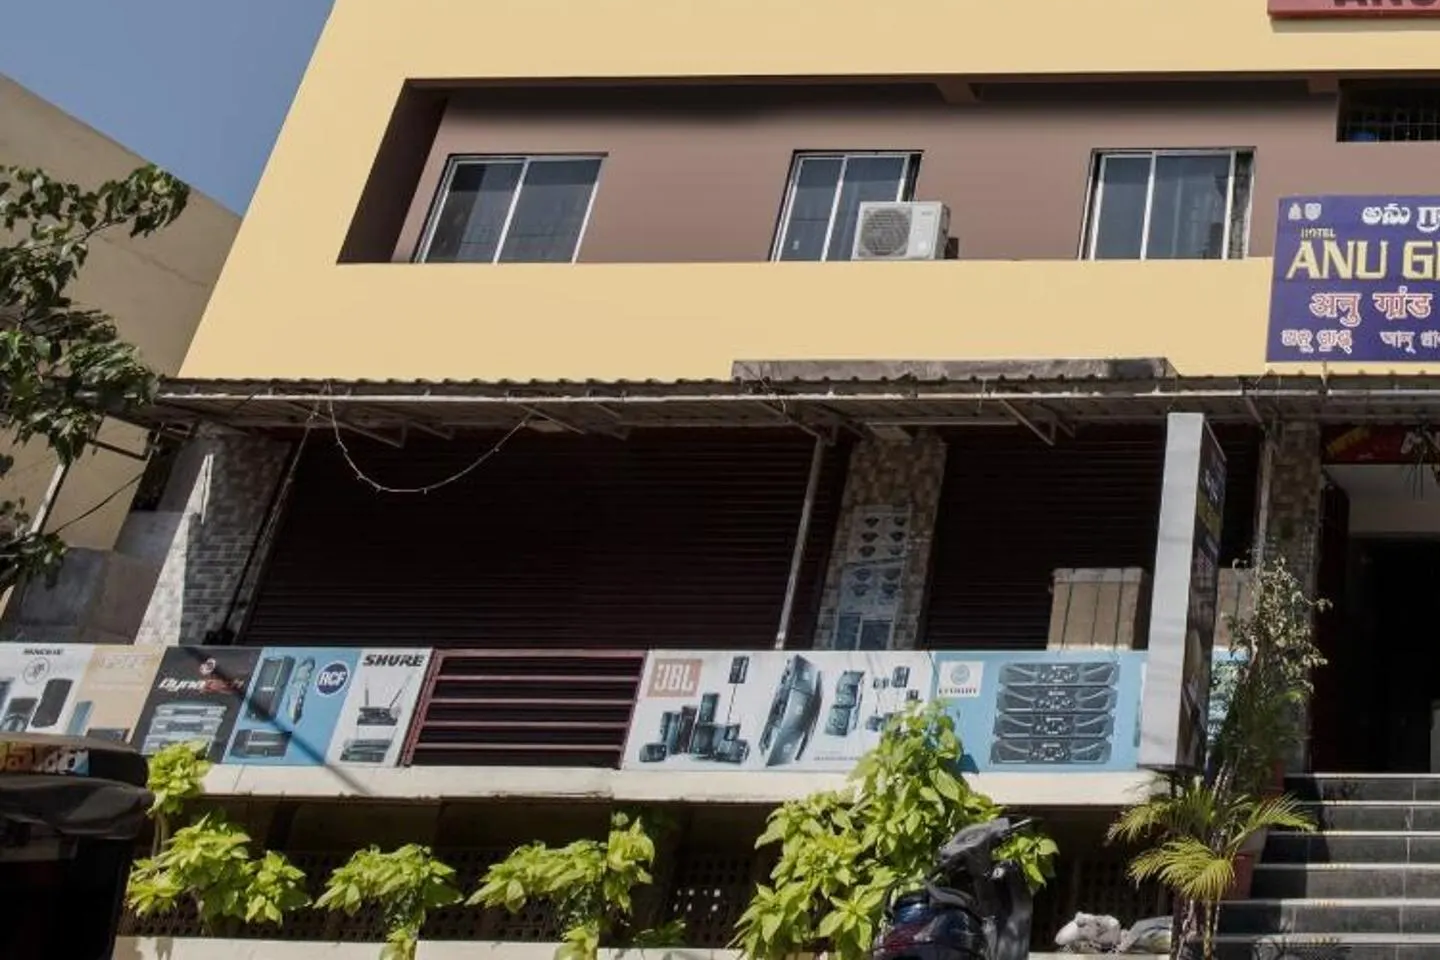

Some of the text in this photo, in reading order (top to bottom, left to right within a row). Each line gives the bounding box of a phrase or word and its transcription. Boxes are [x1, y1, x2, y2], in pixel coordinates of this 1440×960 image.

[1301, 227, 1337, 239] HOTEL
[1286, 241, 1389, 280] ANU
[363, 653, 425, 668] SHURE
[318, 668, 348, 689] RCF
[654, 664, 697, 692] JBL
